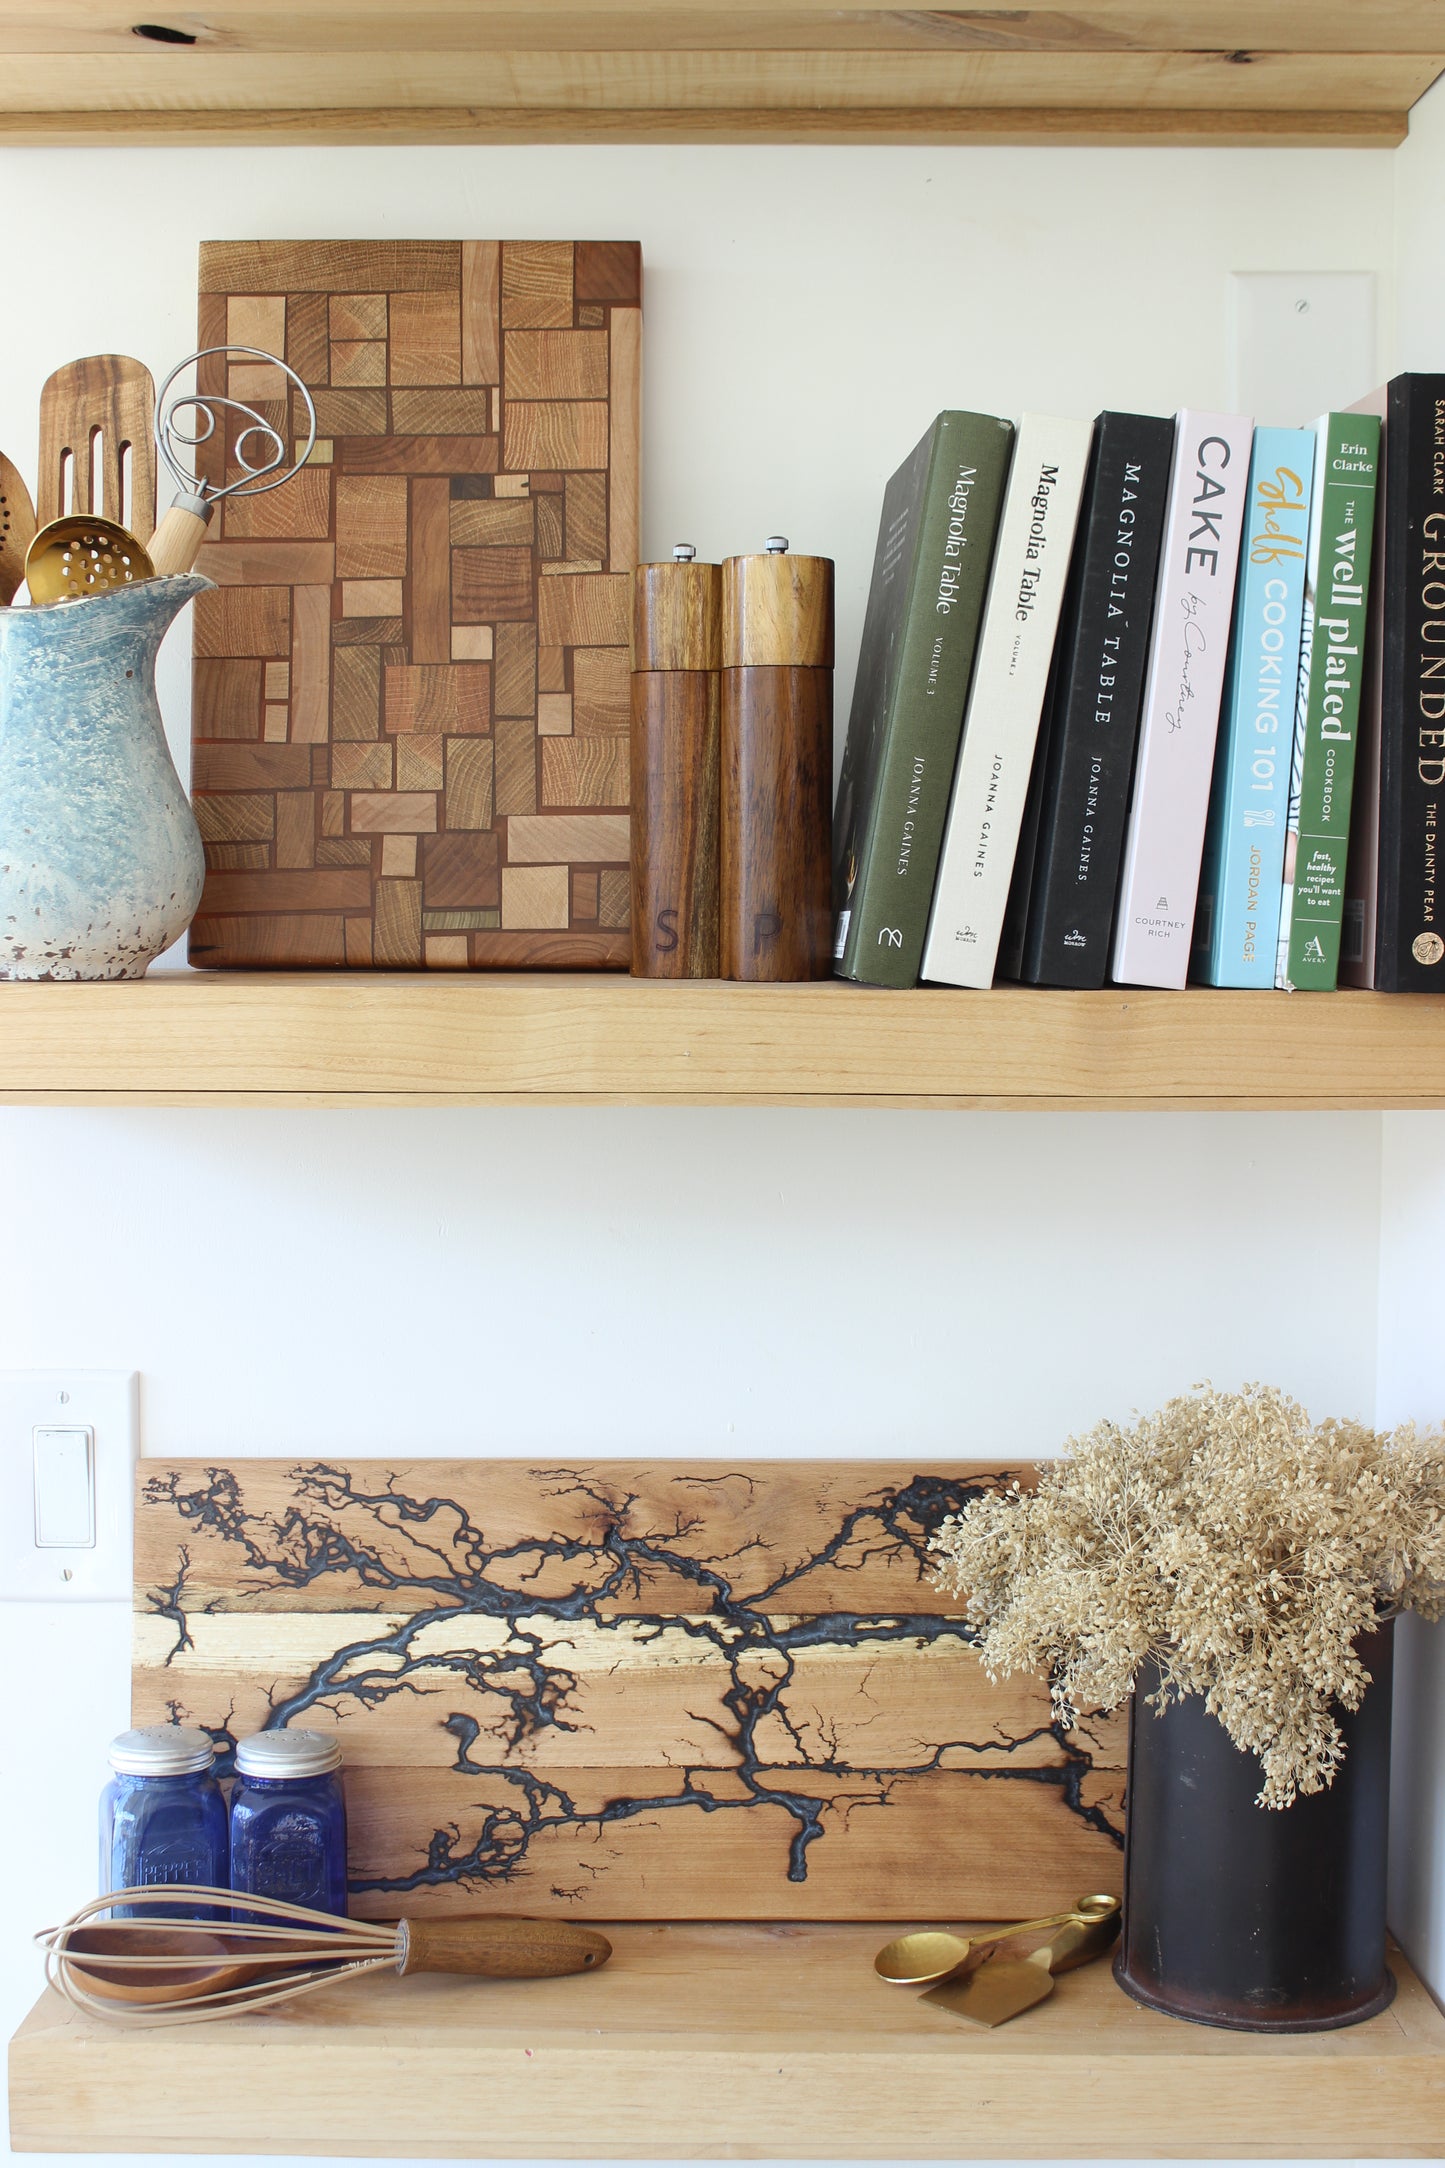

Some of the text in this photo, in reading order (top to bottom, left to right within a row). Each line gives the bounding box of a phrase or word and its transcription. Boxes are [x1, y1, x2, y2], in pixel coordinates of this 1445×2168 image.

[1332, 459, 1373, 473] Clarke
[1340, 443, 1368, 455] Erin
[1433, 399, 1445, 494] SARAH CLARK
[945, 464, 977, 557] Magnolia
[1025, 463, 1059, 559] Magnolia
[936, 562, 962, 615] Table
[1015, 568, 1041, 622] Table
[1095, 462, 1142, 723] MAGNOLIA TABLE
[1166, 436, 1231, 734] CAKE by Courtney
[1010, 635, 1021, 668] VOLUME
[1250, 466, 1306, 792] Shelf COOKING 101
[1418, 512, 1445, 785] GROUNDED
[928, 637, 944, 684] VOLUME
[1318, 500, 1363, 822] THE well plated COOKBOOK
[897, 756, 925, 876] JOANNA GAINES
[973, 754, 1003, 878] JOANNA GAINES
[1078, 756, 1102, 881] JOANNA GAINES
[1306, 862, 1336, 875] healthy
[1306, 874, 1335, 885] recipes
[1312, 851, 1331, 862] fast,
[1423, 803, 1437, 922] THE DAINTY PEAR
[1242, 845, 1261, 963] JORDAN PAGE
[1297, 885, 1341, 896] you'll want
[1307, 898, 1316, 906] to
[656, 909, 678, 952] S
[754, 913, 784, 955] P
[1135, 917, 1186, 929] COURTNEY
[1148, 929, 1171, 938] RICH
